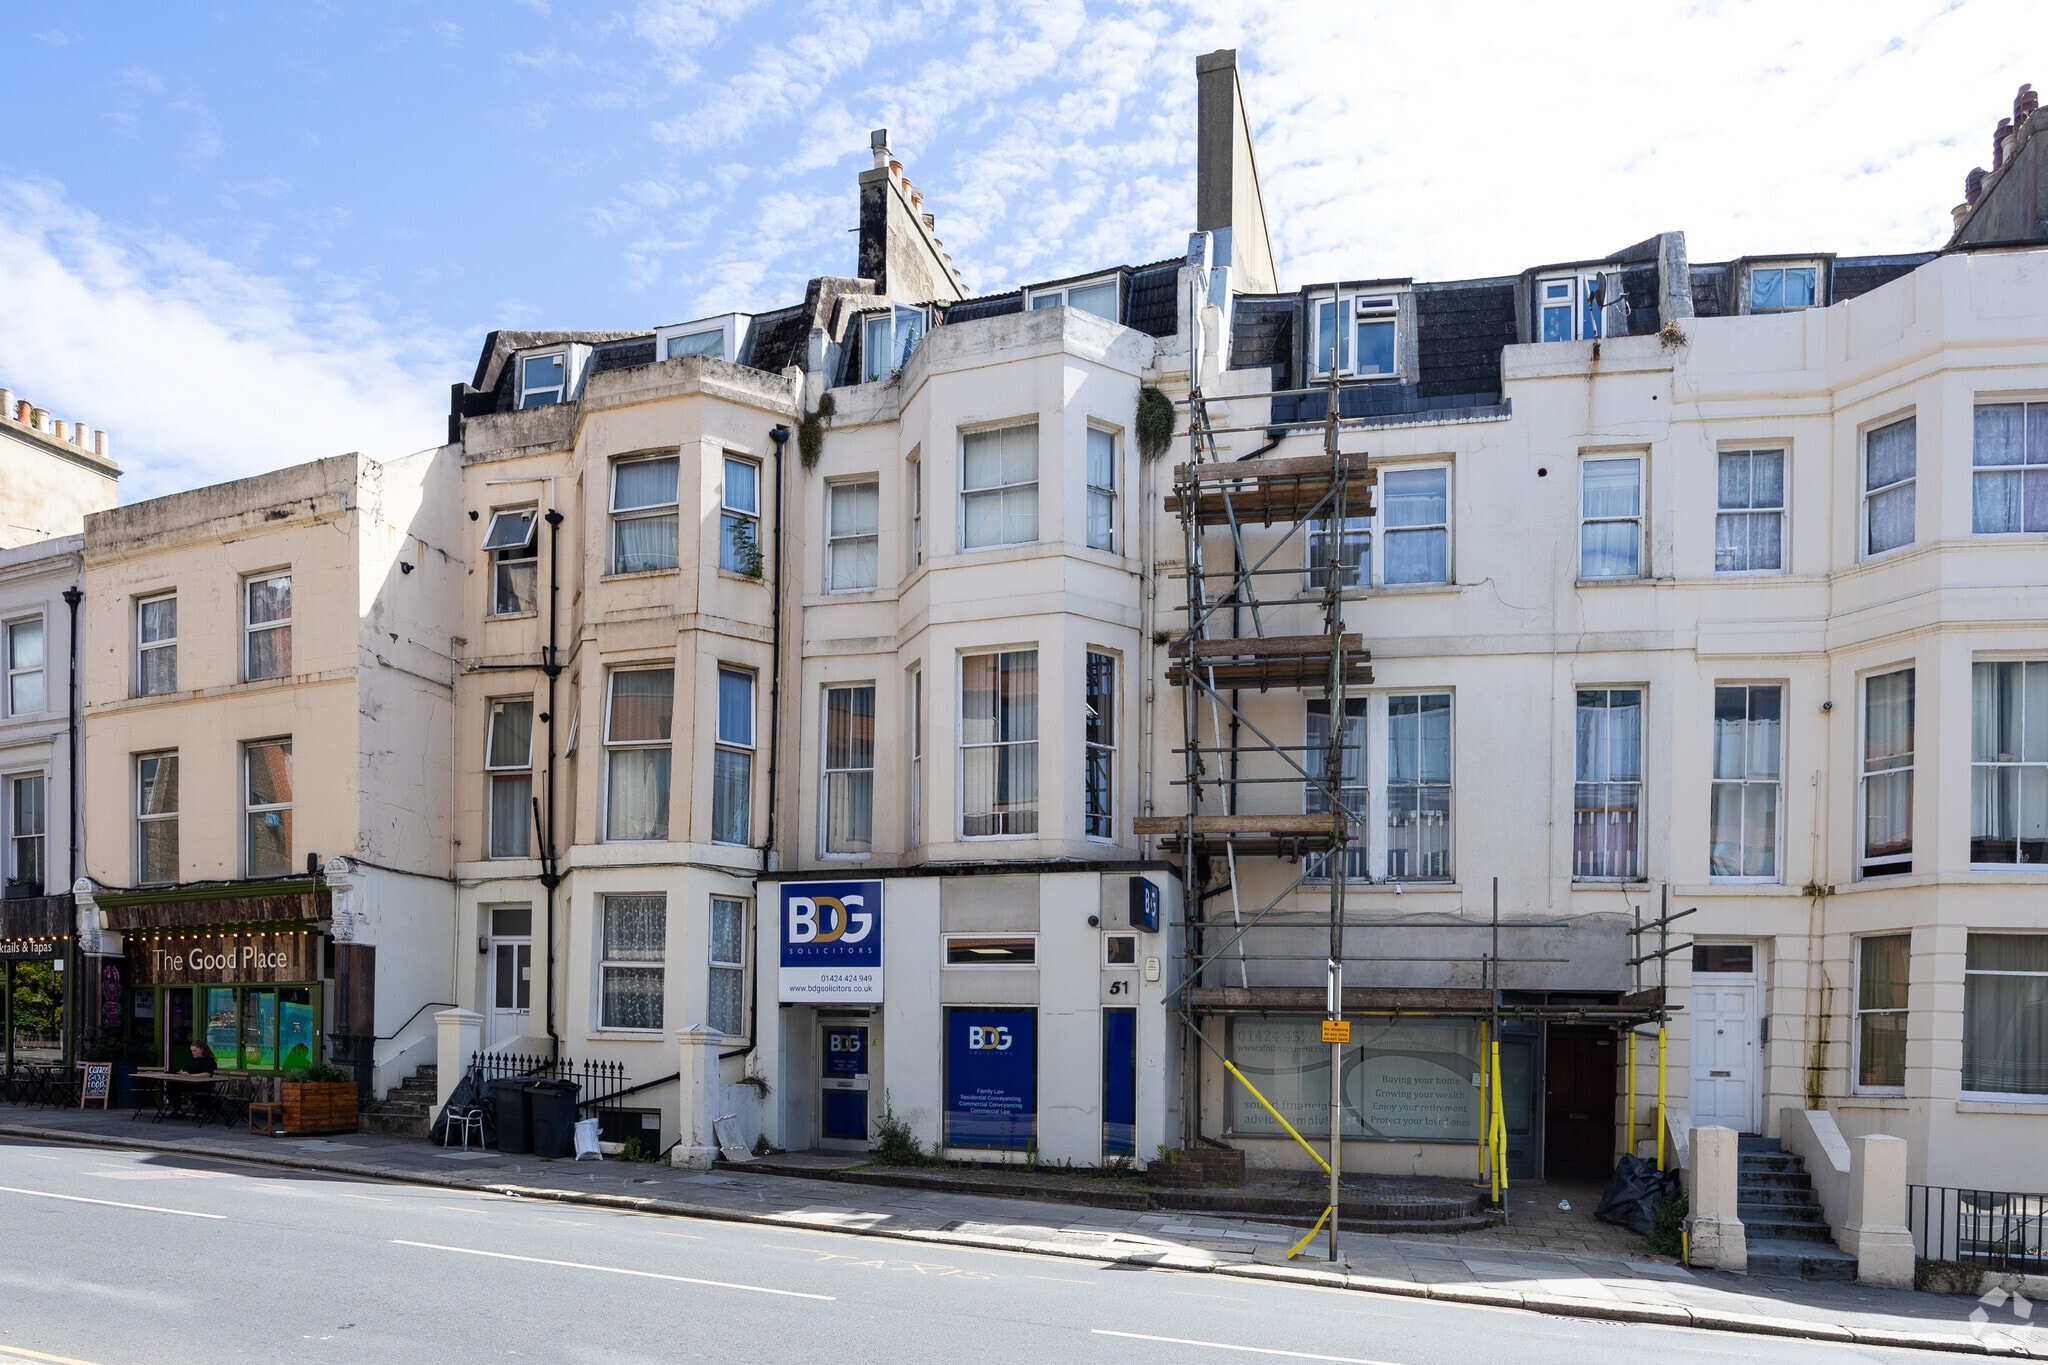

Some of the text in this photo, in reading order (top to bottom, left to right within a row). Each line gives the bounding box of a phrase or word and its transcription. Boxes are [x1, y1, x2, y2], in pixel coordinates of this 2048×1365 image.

[788, 894, 873, 943] BDG
[21, 941, 29, 953] &
[30, 940, 53, 956] Tapas
[788, 946, 873, 955] SOLICITORS
[152, 945, 288, 971] The Good Place
[821, 974, 873, 983] 01424 424 949
[788, 984, 873, 994] www.bdgsolicitors.co.uk
[1109, 980, 1129, 995] 51
[830, 1034, 861, 1052] BDG
[969, 1026, 1013, 1050] BDG
[1237, 1044, 1331, 1054] www.afmanagement.co.u
[1382, 1074, 1460, 1086] Buying your home
[987, 1095, 1022, 1103] Conveyancing
[1375, 1088, 1465, 1100] Growing your wealth
[1243, 1099, 1279, 1110] soud
[1372, 1102, 1469, 1113] Enjoy your retirement
[1370, 1116, 1472, 1127] Protect your loved ones
[815, 1251, 998, 1280] TAXIS
